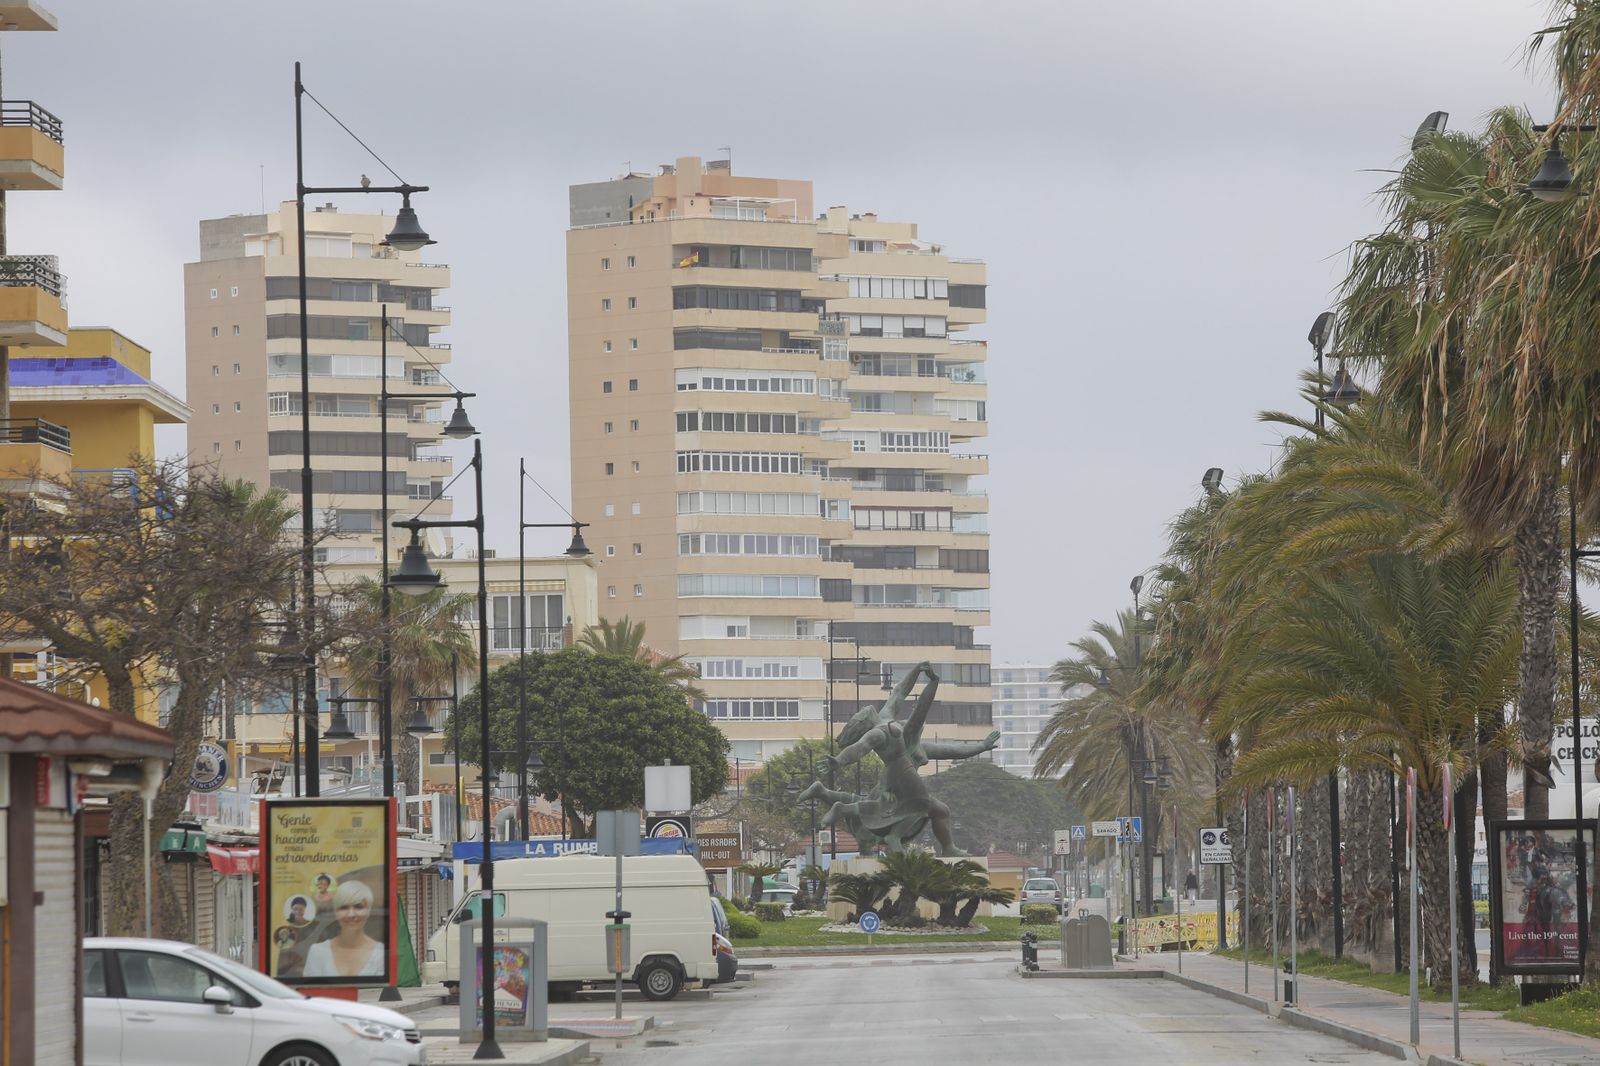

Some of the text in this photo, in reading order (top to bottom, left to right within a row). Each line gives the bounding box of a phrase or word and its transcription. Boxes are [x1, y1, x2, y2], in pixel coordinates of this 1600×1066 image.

[1557, 747, 1600, 760] CHCK
[277, 814, 312, 828] Gente
[275, 834, 320, 845] haciendo
[710, 838, 737, 847] ASADAS
[525, 842, 598, 855] LA RUMB
[275, 852, 359, 863] extraordinarias
[701, 850, 731, 860] HILL-OUT
[1508, 931, 1578, 940] Live the 19th cent
